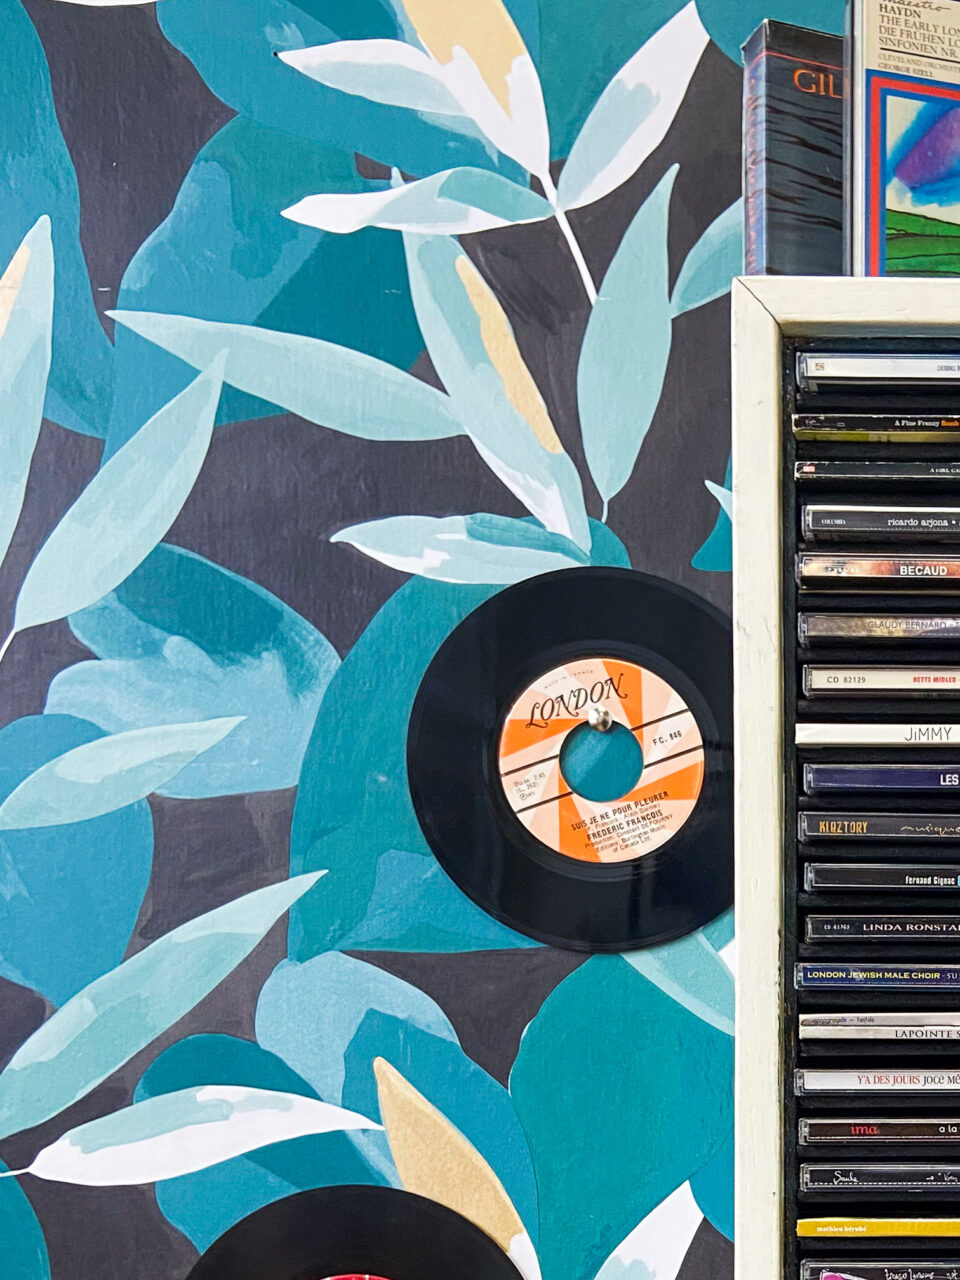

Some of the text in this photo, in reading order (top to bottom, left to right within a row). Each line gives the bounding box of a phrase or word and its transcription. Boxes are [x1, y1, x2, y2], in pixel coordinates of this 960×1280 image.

[879, 4, 921, 18] HAYDN
[879, 15, 901, 27] THE
[904, 19, 939, 34] EARLY
[879, 25, 898, 36] DIE
[888, 518, 919, 526] ricardo
[921, 518, 949, 528] arjona
[900, 565, 947, 575] BECAUD
[525, 673, 628, 729] LONDON
[940, 774, 960, 785] LES
[571, 791, 669, 831] SUIS JE NE POUR PLEURER
[587, 823, 624, 841] FREDERIC
[864, 923, 902, 931] LINDA
[807, 971, 845, 979] LONDON
[848, 971, 882, 979] JEWISH
[884, 971, 909, 979] MALE
[895, 1029, 952, 1039] LAPOINTE
